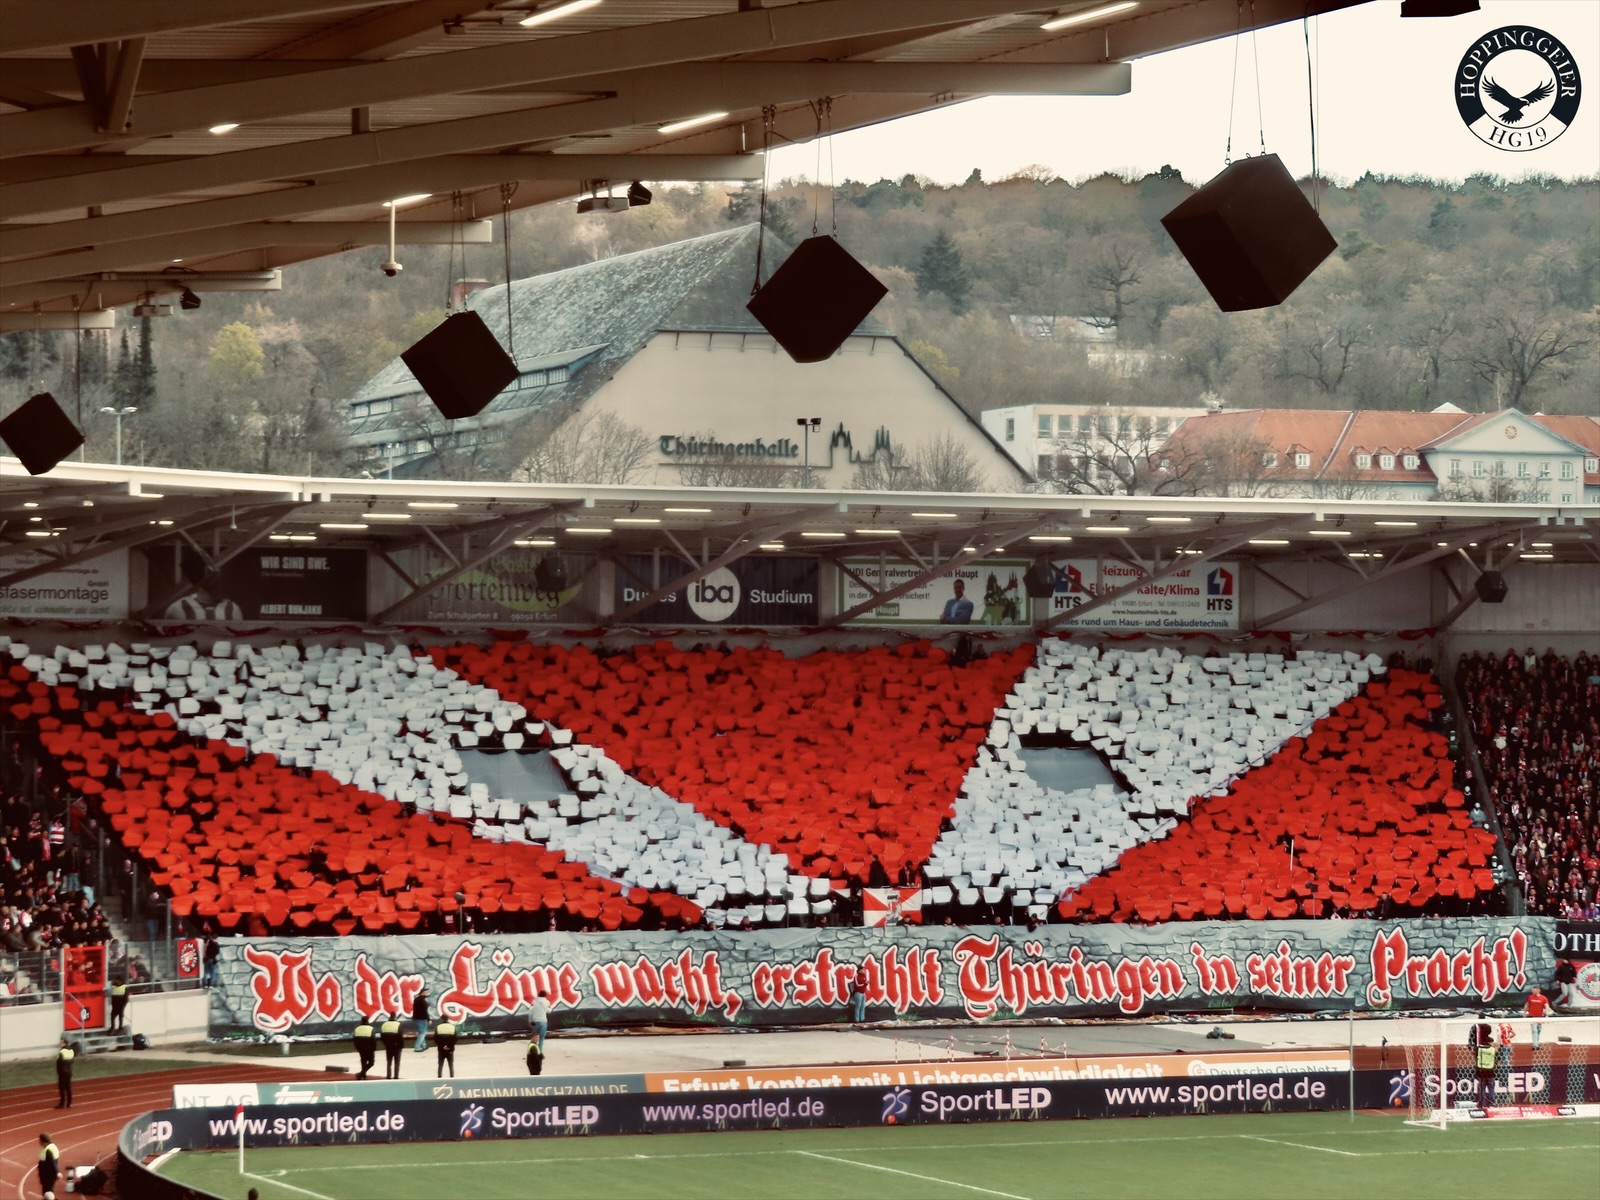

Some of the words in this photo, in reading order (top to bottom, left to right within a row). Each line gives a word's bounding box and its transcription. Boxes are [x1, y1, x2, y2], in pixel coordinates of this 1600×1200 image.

[659, 435, 799, 458] Thüringenhalle
[261, 556, 280, 569] WIR
[282, 556, 305, 570] SIND
[955, 570, 978, 579] Haupt
[694, 579, 733, 604] iba
[750, 589, 813, 604] Studium
[1055, 597, 1081, 610] HTS
[1206, 598, 1233, 611] HTS
[1081, 617, 1101, 627] rund
[1103, 619, 1115, 627] um
[1119, 617, 1142, 628] Haus-
[1145, 617, 1161, 628] und
[1163, 616, 1229, 629] Gebäudetechnik
[244, 941, 342, 1032] Wo
[354, 950, 424, 1020] der
[437, 940, 583, 1025] Löwe
[588, 945, 743, 1022] wacht,
[750, 943, 945, 1014] erstrahlt
[953, 932, 1188, 1021] Thüringen
[1189, 940, 1242, 1000] in
[1246, 939, 1356, 1000] seiner
[1367, 925, 1528, 1010] Pracht!
[920, 1086, 1053, 1120] SportLED
[1104, 1075, 1326, 1108] www.sportled.de
[491, 1104, 600, 1135] SportLED
[642, 1096, 825, 1123] www.sportled.de
[209, 1109, 405, 1140] www.sportled.de
